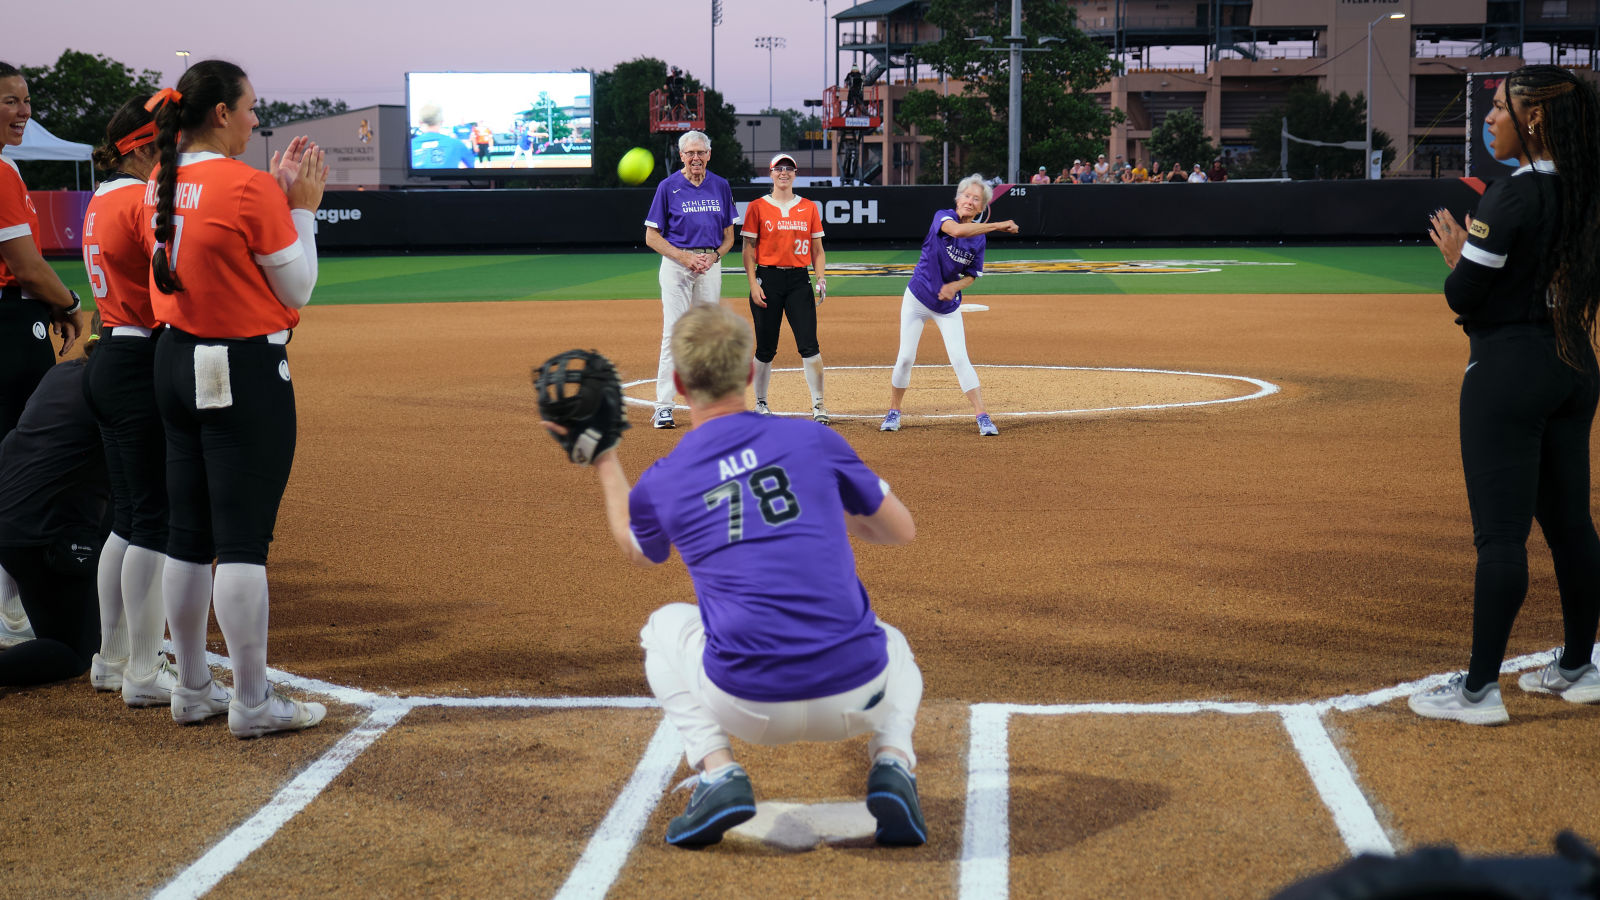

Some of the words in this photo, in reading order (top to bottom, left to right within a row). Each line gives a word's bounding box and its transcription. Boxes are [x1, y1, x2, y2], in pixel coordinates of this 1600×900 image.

[1010, 187, 1026, 196] 215
[681, 199, 720, 207] ATHLETES
[315, 209, 362, 224] ague
[794, 239, 809, 255] 26
[84, 244, 108, 298] 15
[719, 448, 758, 480] ALO
[703, 465, 801, 543] 78
